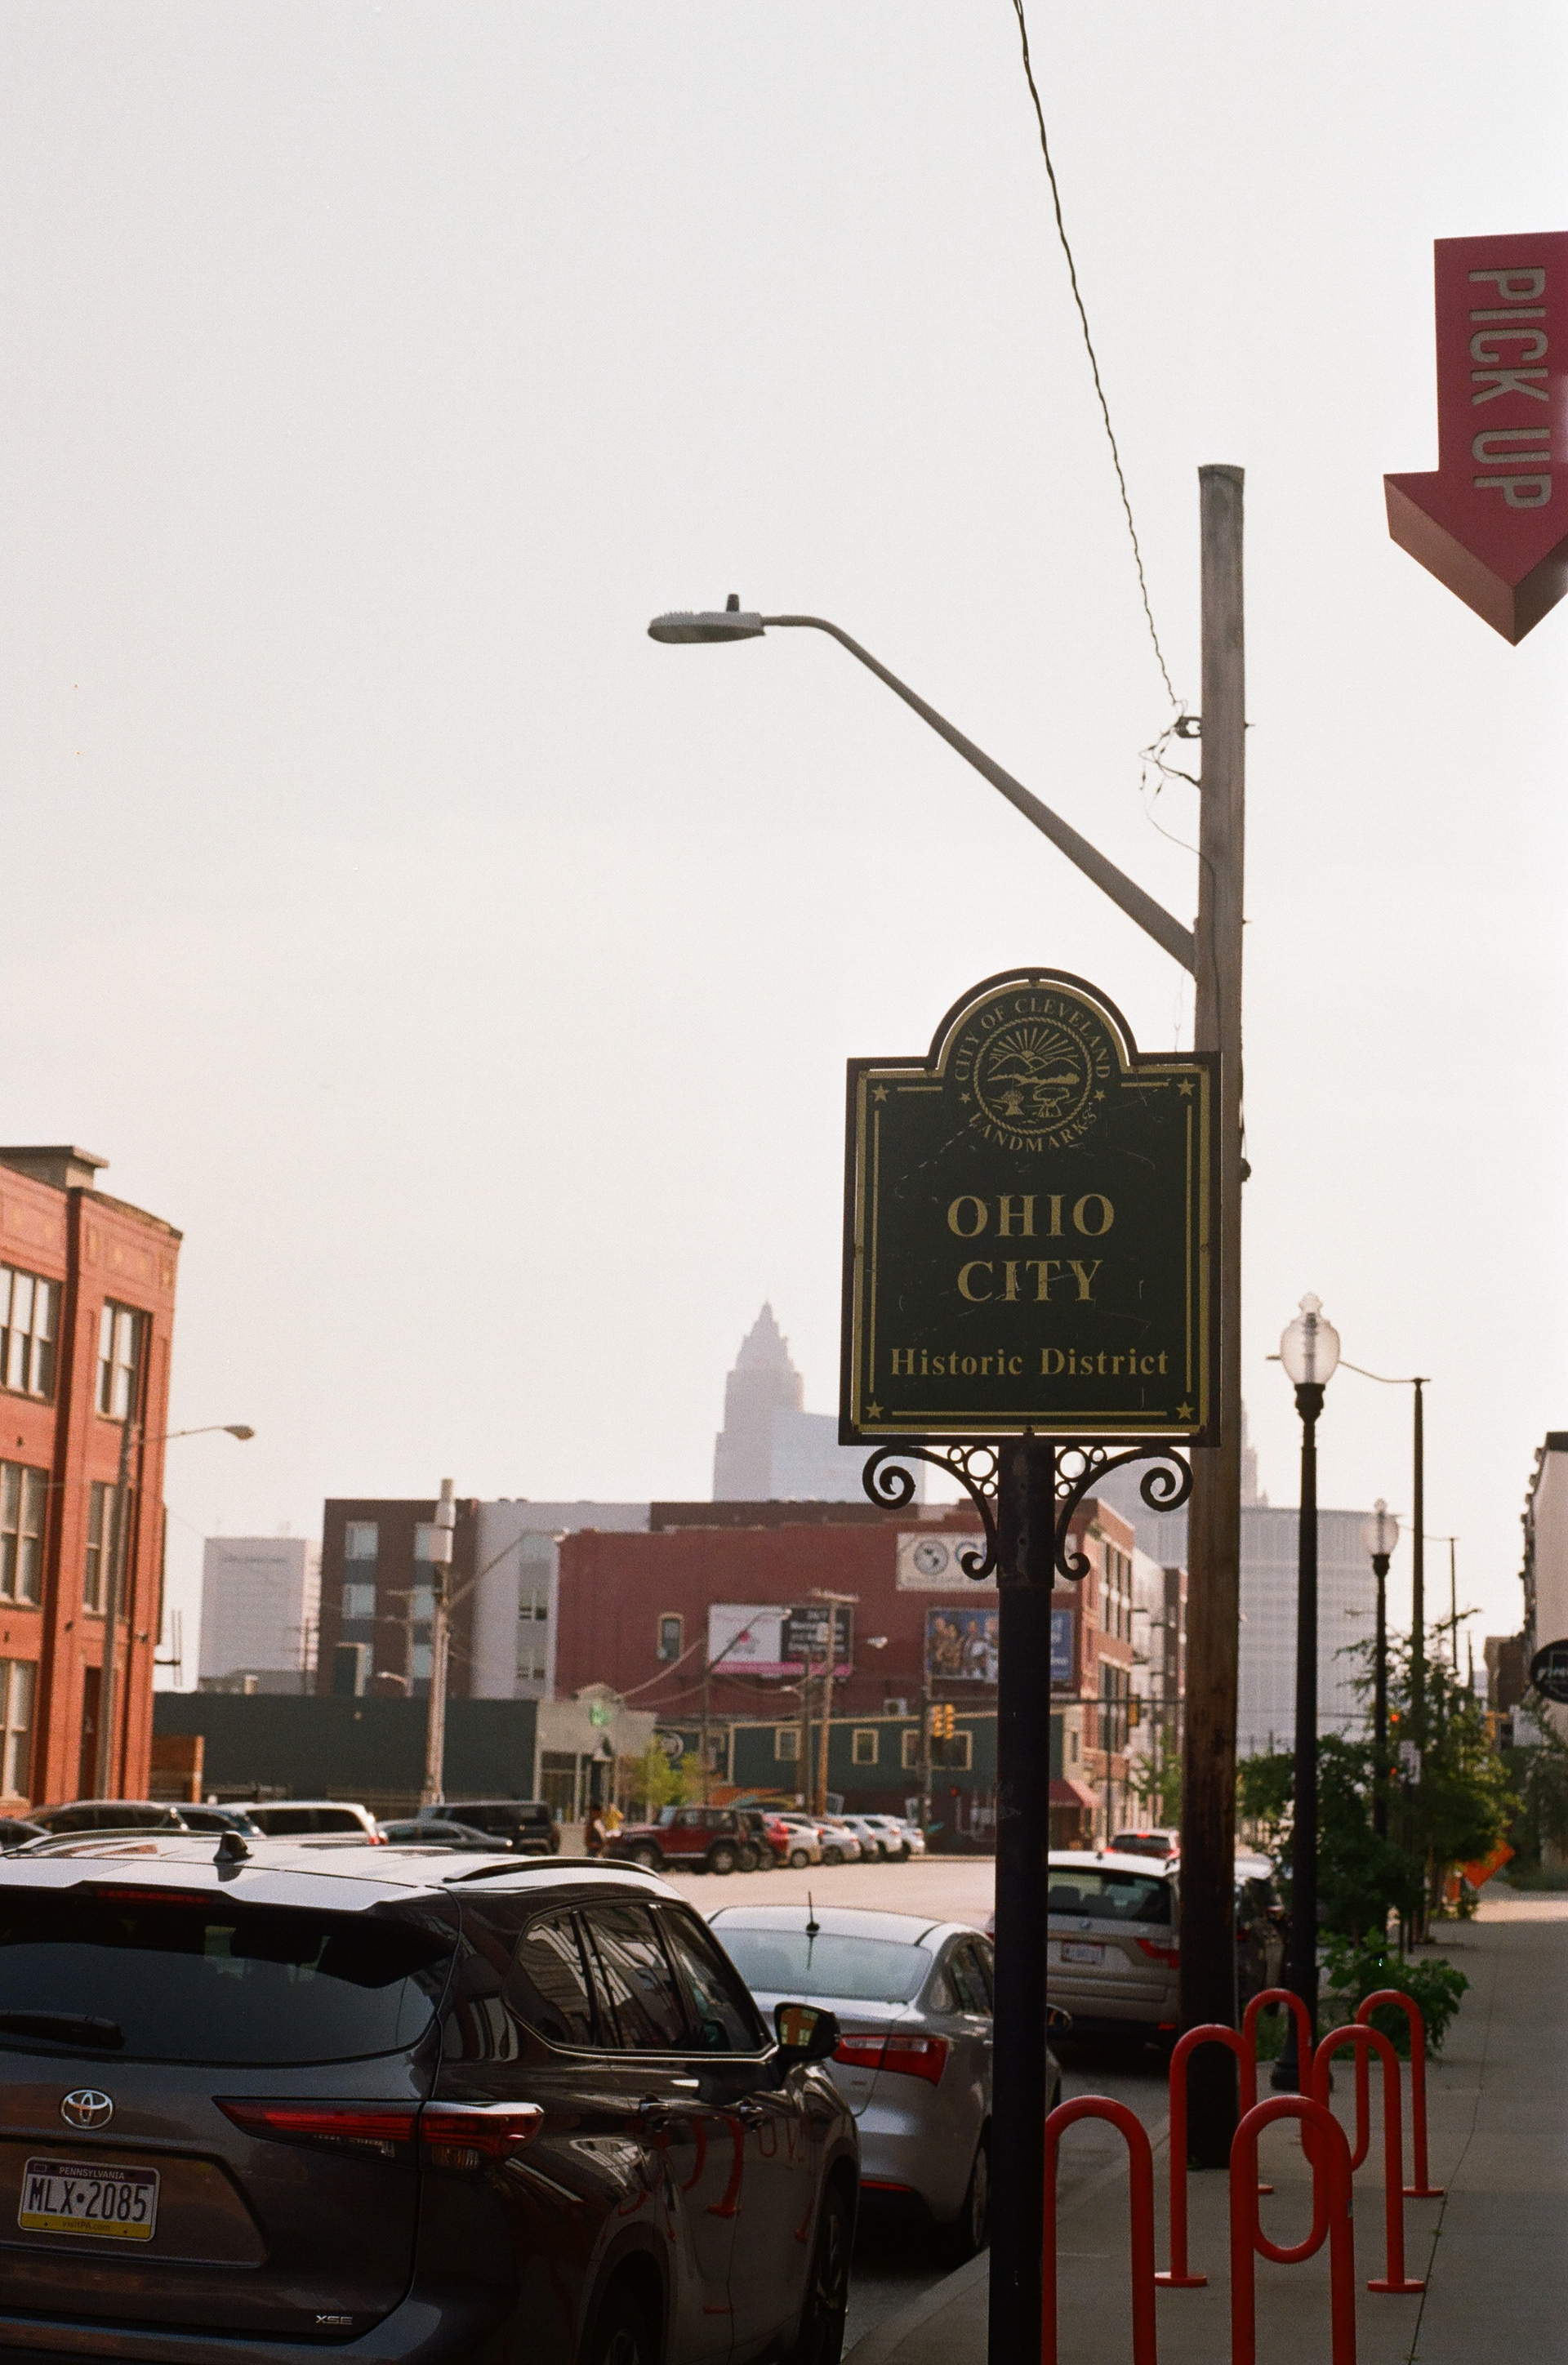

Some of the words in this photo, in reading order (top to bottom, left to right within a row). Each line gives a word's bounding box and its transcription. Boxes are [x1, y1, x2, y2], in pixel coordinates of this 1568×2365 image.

[1468, 265, 1550, 406] PICK
[1471, 425, 1552, 510] UP
[955, 1031, 980, 1082] CITY
[981, 1004, 1005, 1030] OF
[1014, 996, 1111, 1079] CLEVELAND
[969, 1108, 1097, 1152] LANDMARKS
[947, 1193, 1116, 1238] OHIO
[957, 1260, 1104, 1303] CITY
[890, 1347, 1023, 1377] Historic
[1040, 1347, 1169, 1376] District
[59, 2166, 125, 2180] PENNSYLVANIA
[62, 2220, 111, 2232] visitPA.com
[315, 2314, 354, 2326] XSE
